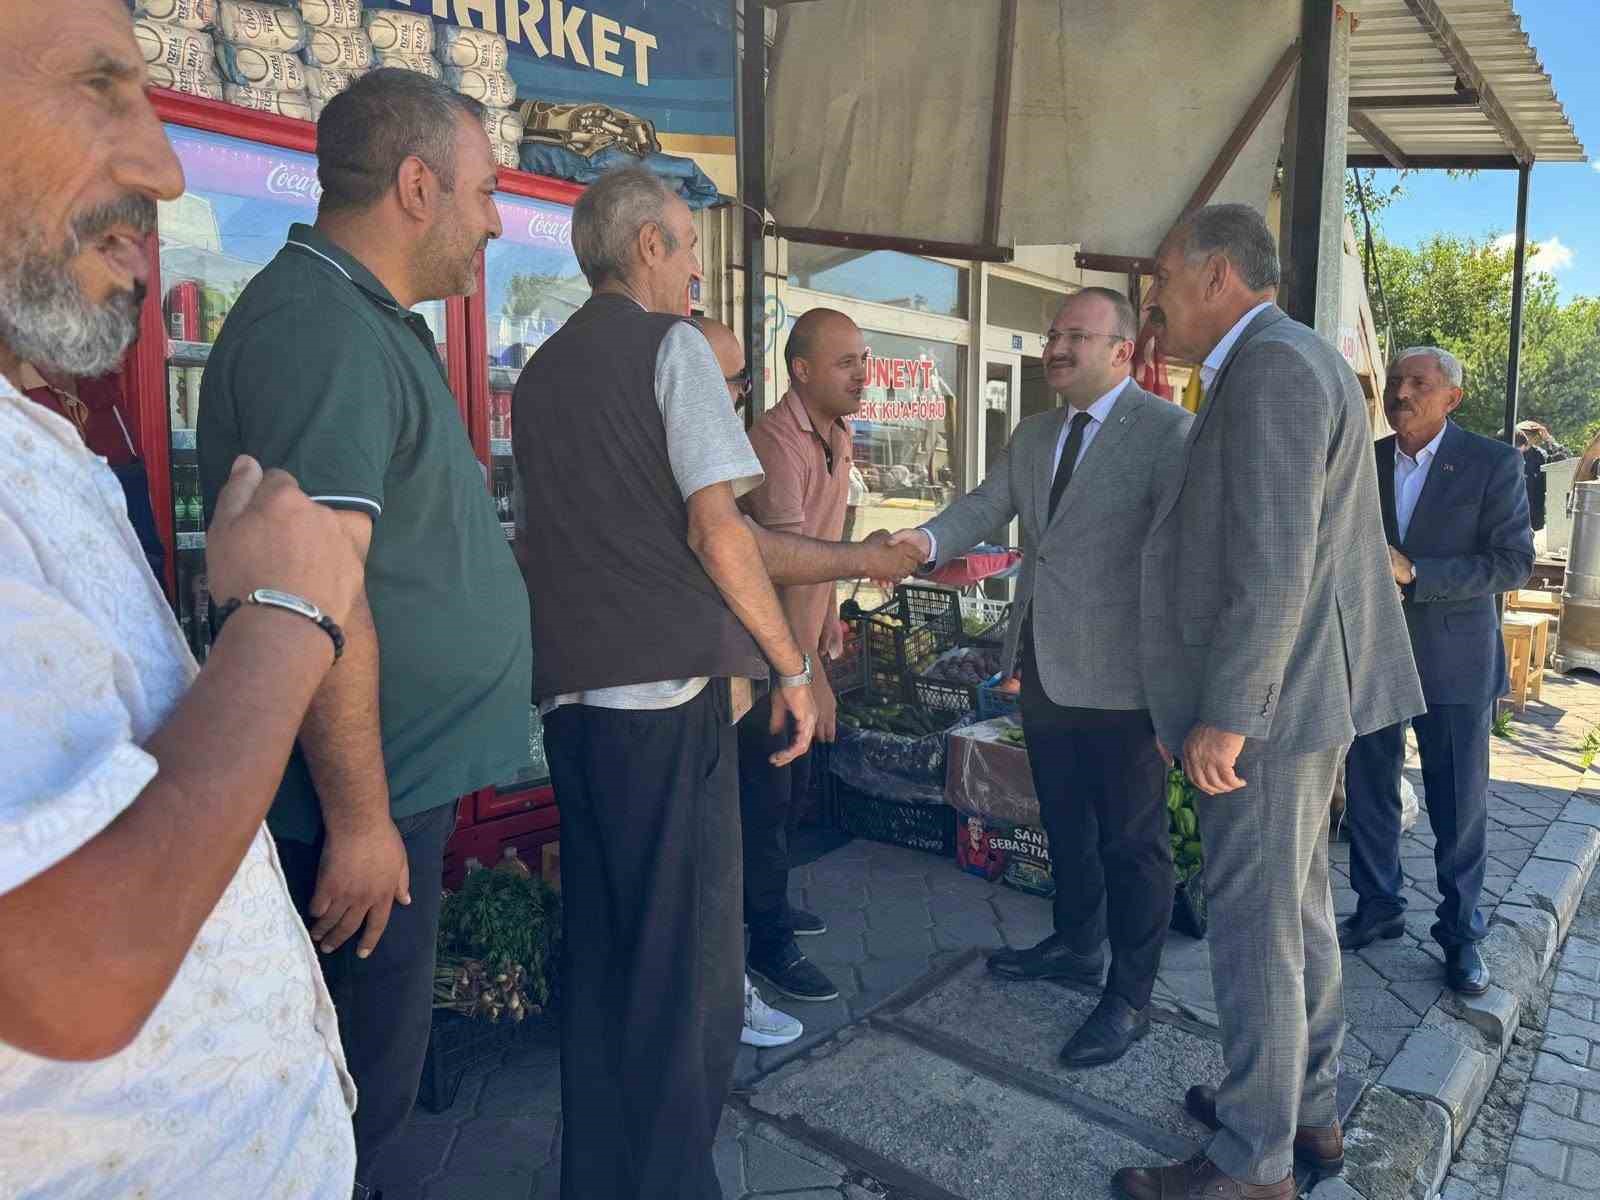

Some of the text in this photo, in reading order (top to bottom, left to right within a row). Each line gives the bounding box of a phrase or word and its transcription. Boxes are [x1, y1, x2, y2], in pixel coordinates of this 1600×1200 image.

[167, 37, 179, 65] TUZU
[395, 0, 658, 87] ARKET
[863, 346, 935, 391] ÜNEYT
[988, 838, 1052, 862] SEBASTIA
[1014, 828, 1043, 846] SAN
